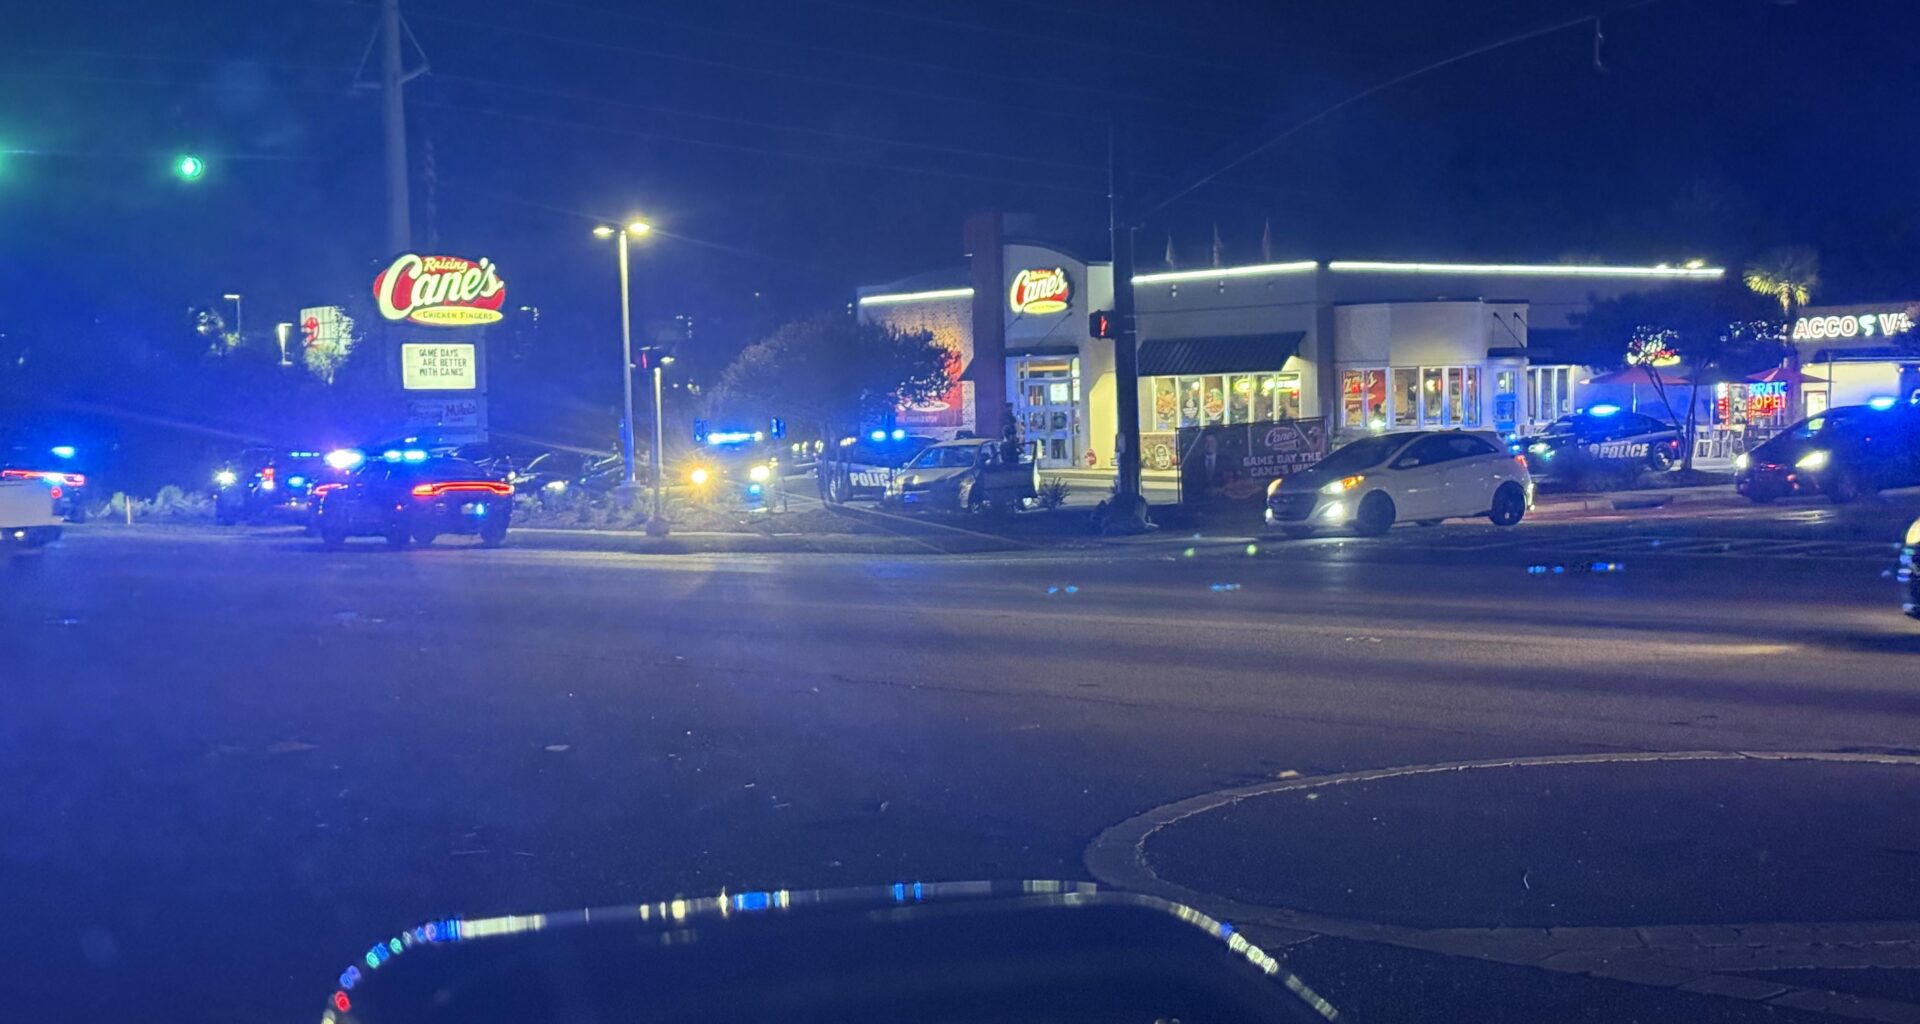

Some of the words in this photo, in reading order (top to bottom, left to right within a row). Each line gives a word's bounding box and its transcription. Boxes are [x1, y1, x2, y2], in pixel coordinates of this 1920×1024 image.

[424, 257, 468, 273] Raising
[379, 254, 505, 320] Cane's
[1010, 267, 1068, 313] Cane's
[422, 310, 458, 319] CHICKEN
[460, 311, 493, 320] FINGERS
[419, 348, 438, 357] GAME
[440, 348, 459, 357] DAYS
[422, 358, 437, 367] ARE
[440, 358, 468, 367] BETTER
[440, 368, 464, 377] CANES
[1265, 427, 1300, 447] Cane's
[1599, 442, 1650, 459] POLICE
[1243, 455, 1275, 467] GAME
[1277, 453, 1297, 465] DAY
[1300, 451, 1323, 463] THE
[849, 472, 892, 487] POLIC
